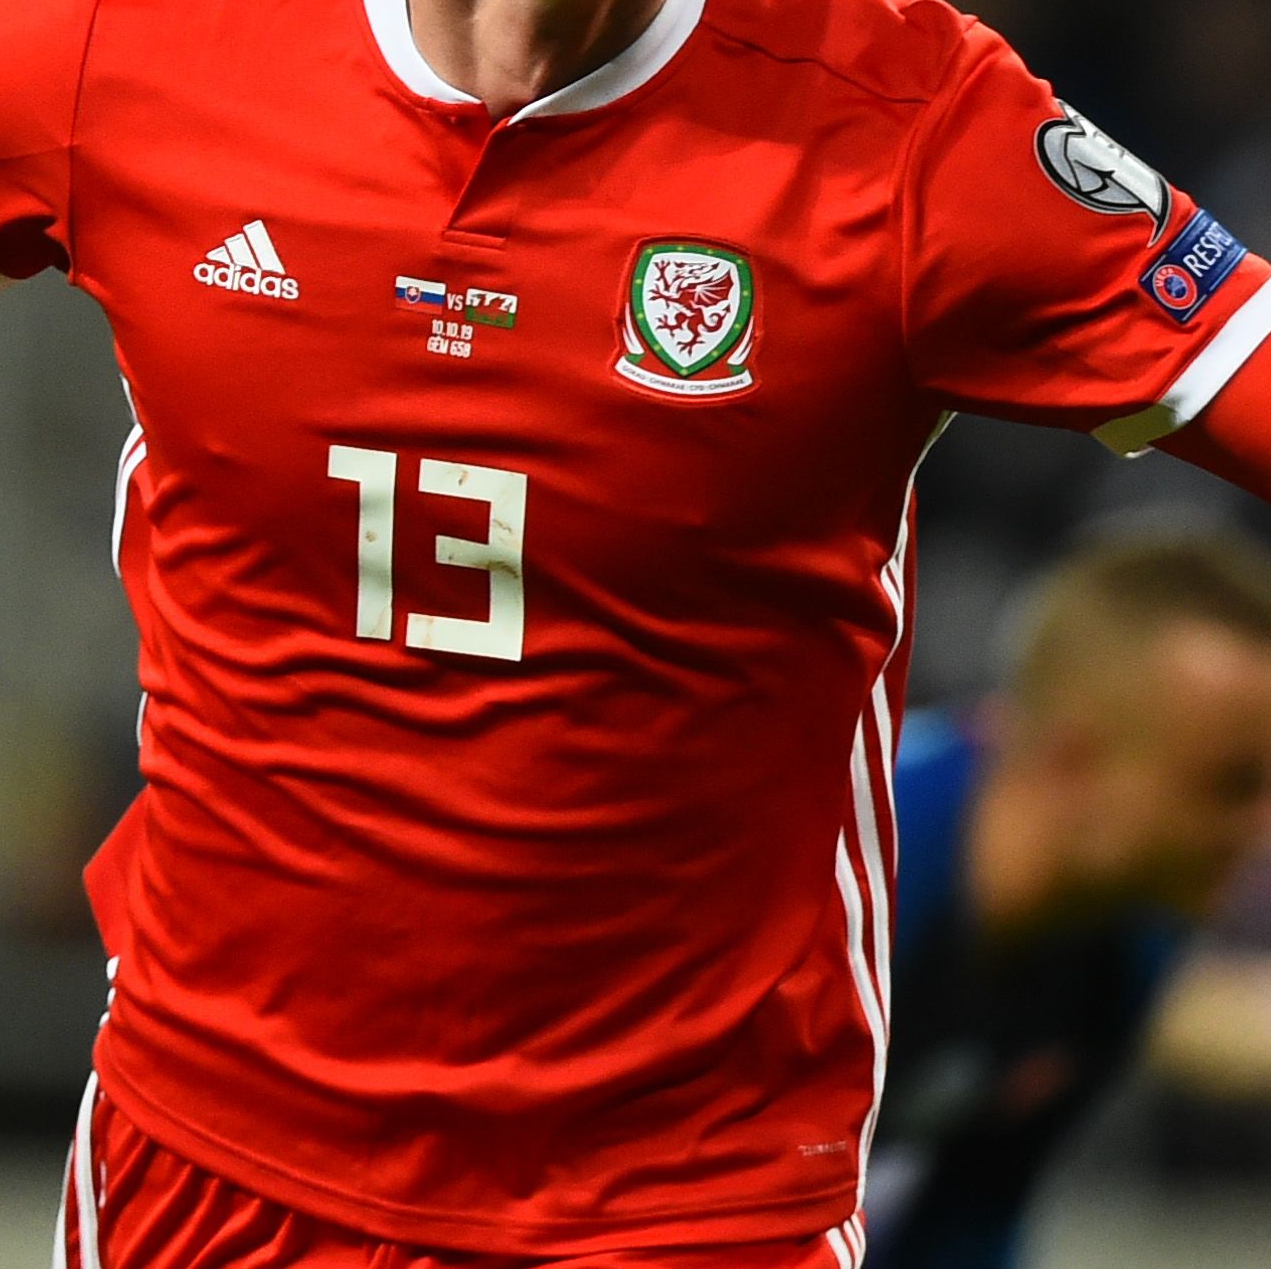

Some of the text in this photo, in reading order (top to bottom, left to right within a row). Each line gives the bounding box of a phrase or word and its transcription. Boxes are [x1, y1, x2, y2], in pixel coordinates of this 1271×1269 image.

[1182, 221, 1233, 278] RESPEC
[193, 263, 299, 300] adidas
[1155, 268, 1174, 287] UEFA
[446, 293, 464, 311] VS
[431, 319, 473, 340] 10.10.19
[327, 444, 528, 662] 13
